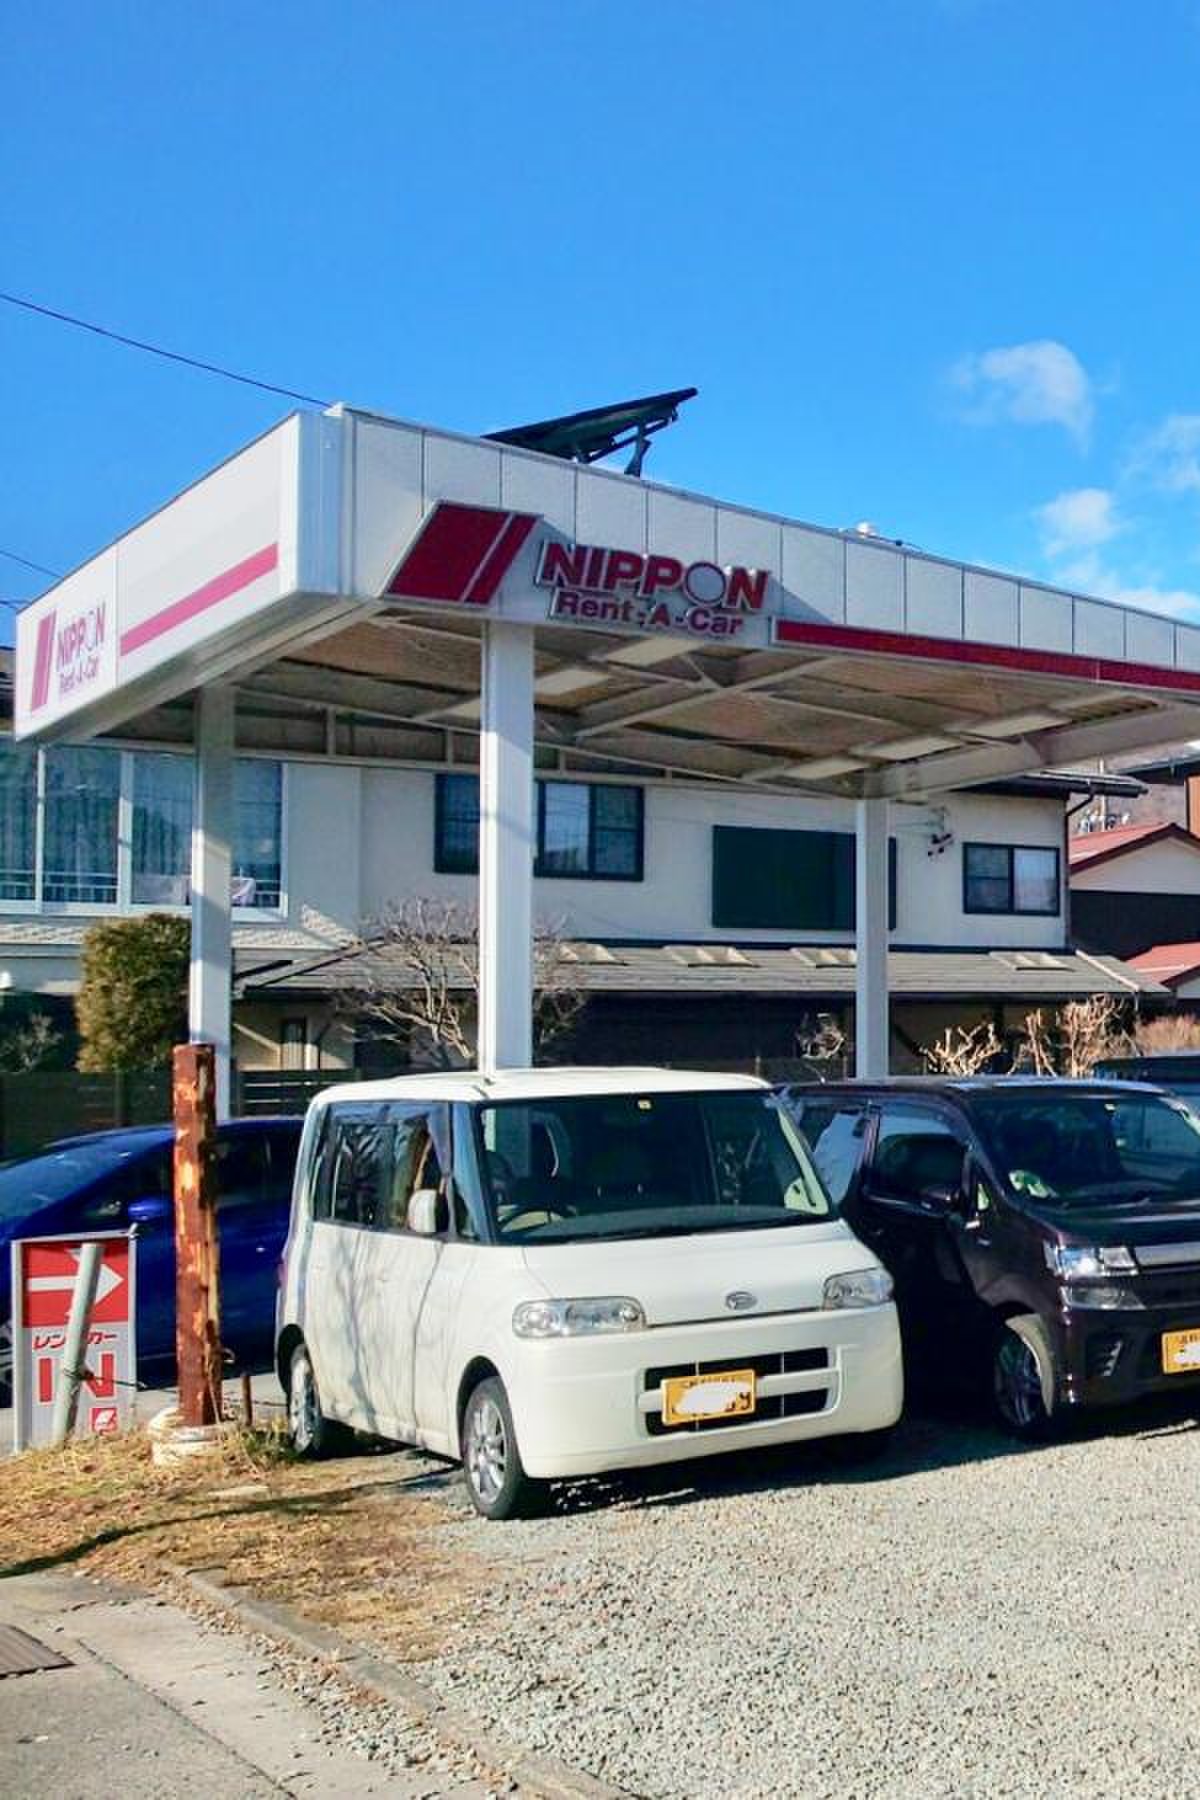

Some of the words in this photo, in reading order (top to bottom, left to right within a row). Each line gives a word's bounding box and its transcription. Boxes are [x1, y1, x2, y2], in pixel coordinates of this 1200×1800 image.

[537, 542, 769, 609] NIPPON
[34, 1331, 117, 1349] レンカー
